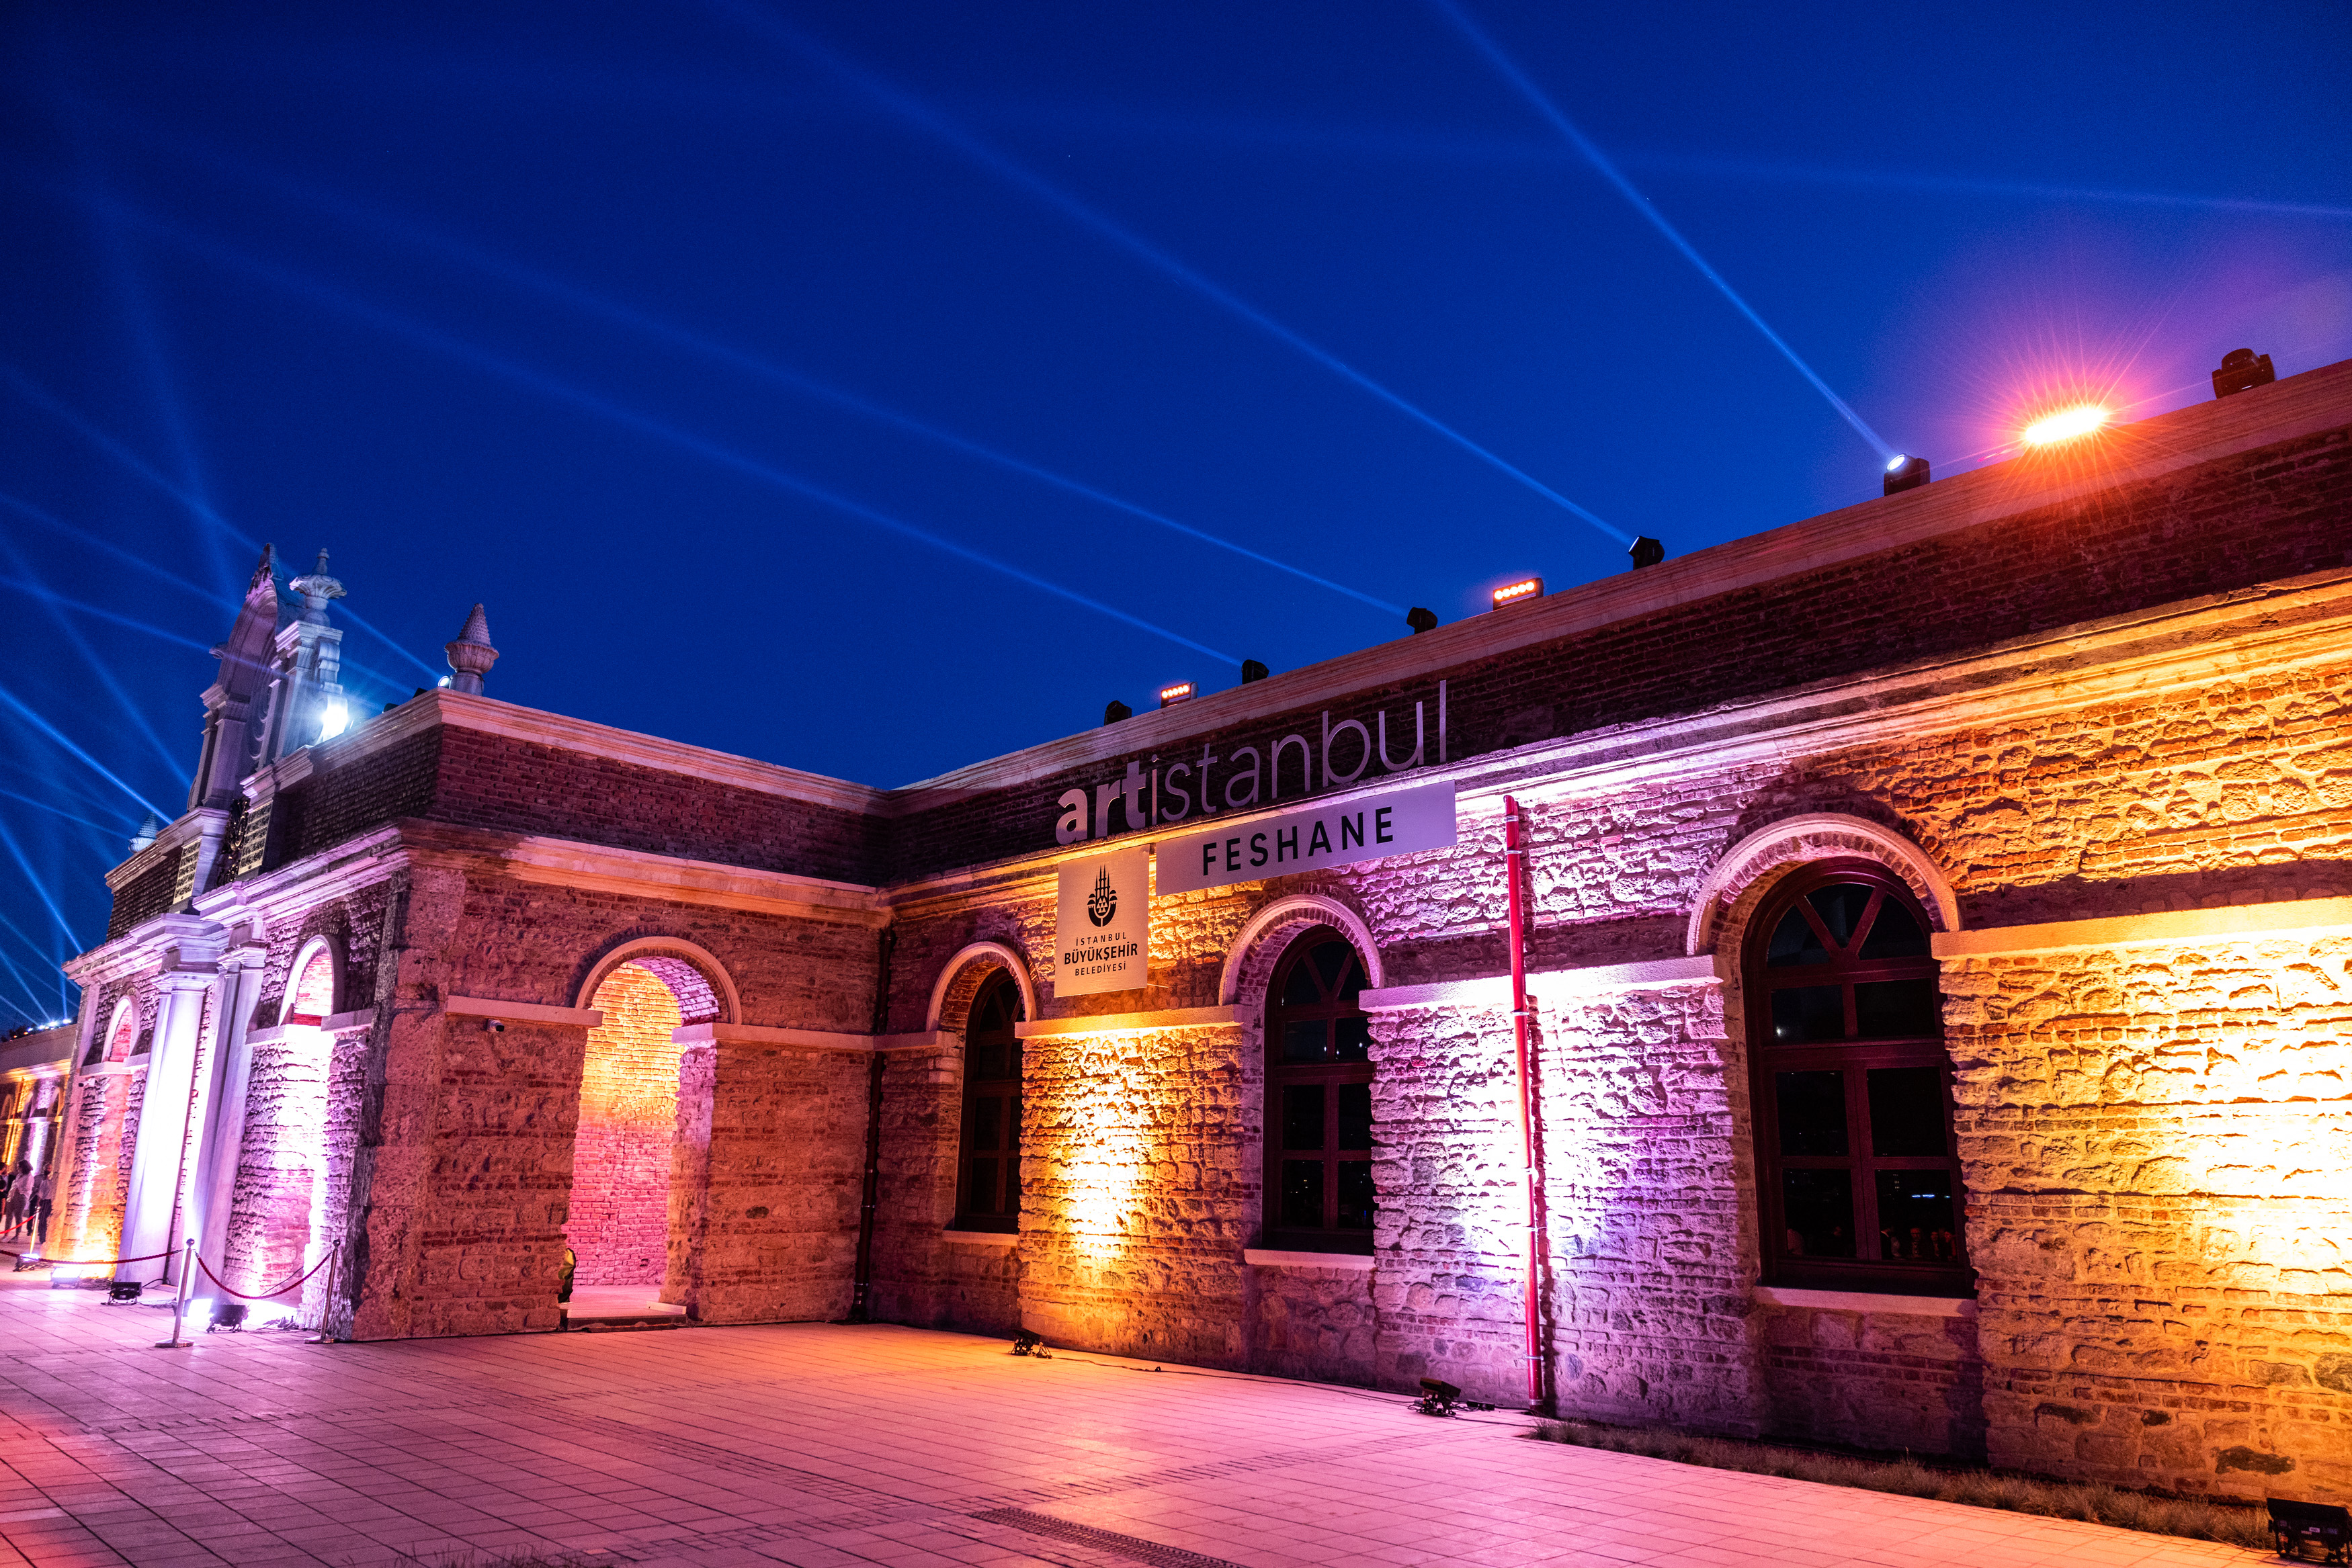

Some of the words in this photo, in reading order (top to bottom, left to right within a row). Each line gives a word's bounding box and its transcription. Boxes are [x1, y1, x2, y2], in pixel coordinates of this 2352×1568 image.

[1202, 806, 1394, 875] FESHANE
[1076, 932, 1127, 946] İSTANBUL
[1064, 941, 1138, 965] BÜYÜKŞEHİR
[1075, 961, 1126, 975] BELEDİYESİ
